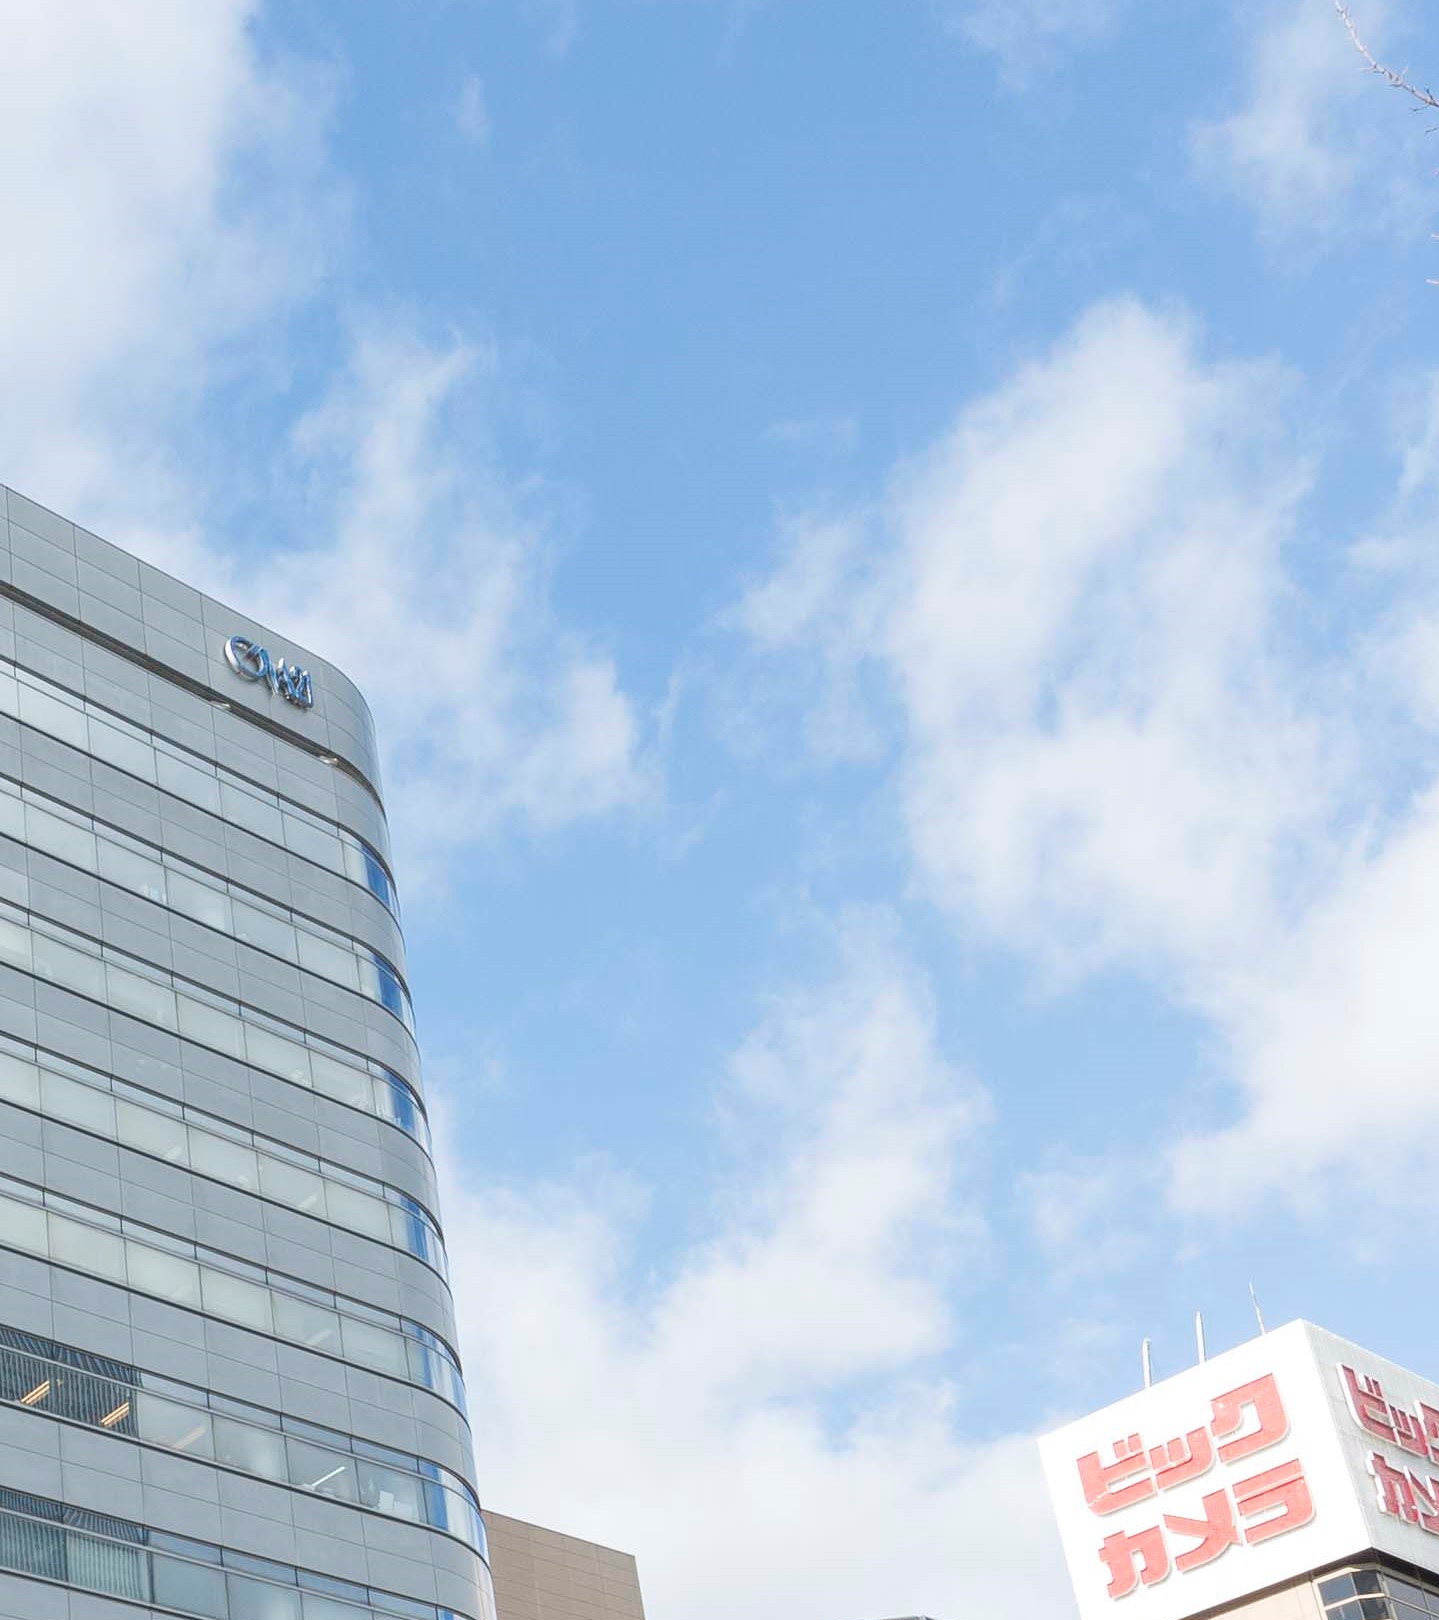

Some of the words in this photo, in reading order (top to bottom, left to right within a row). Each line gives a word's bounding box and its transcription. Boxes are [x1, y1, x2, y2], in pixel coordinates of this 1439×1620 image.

[1076, 1373, 1290, 1515] ビック
[1098, 1459, 1315, 1599] カメラ
